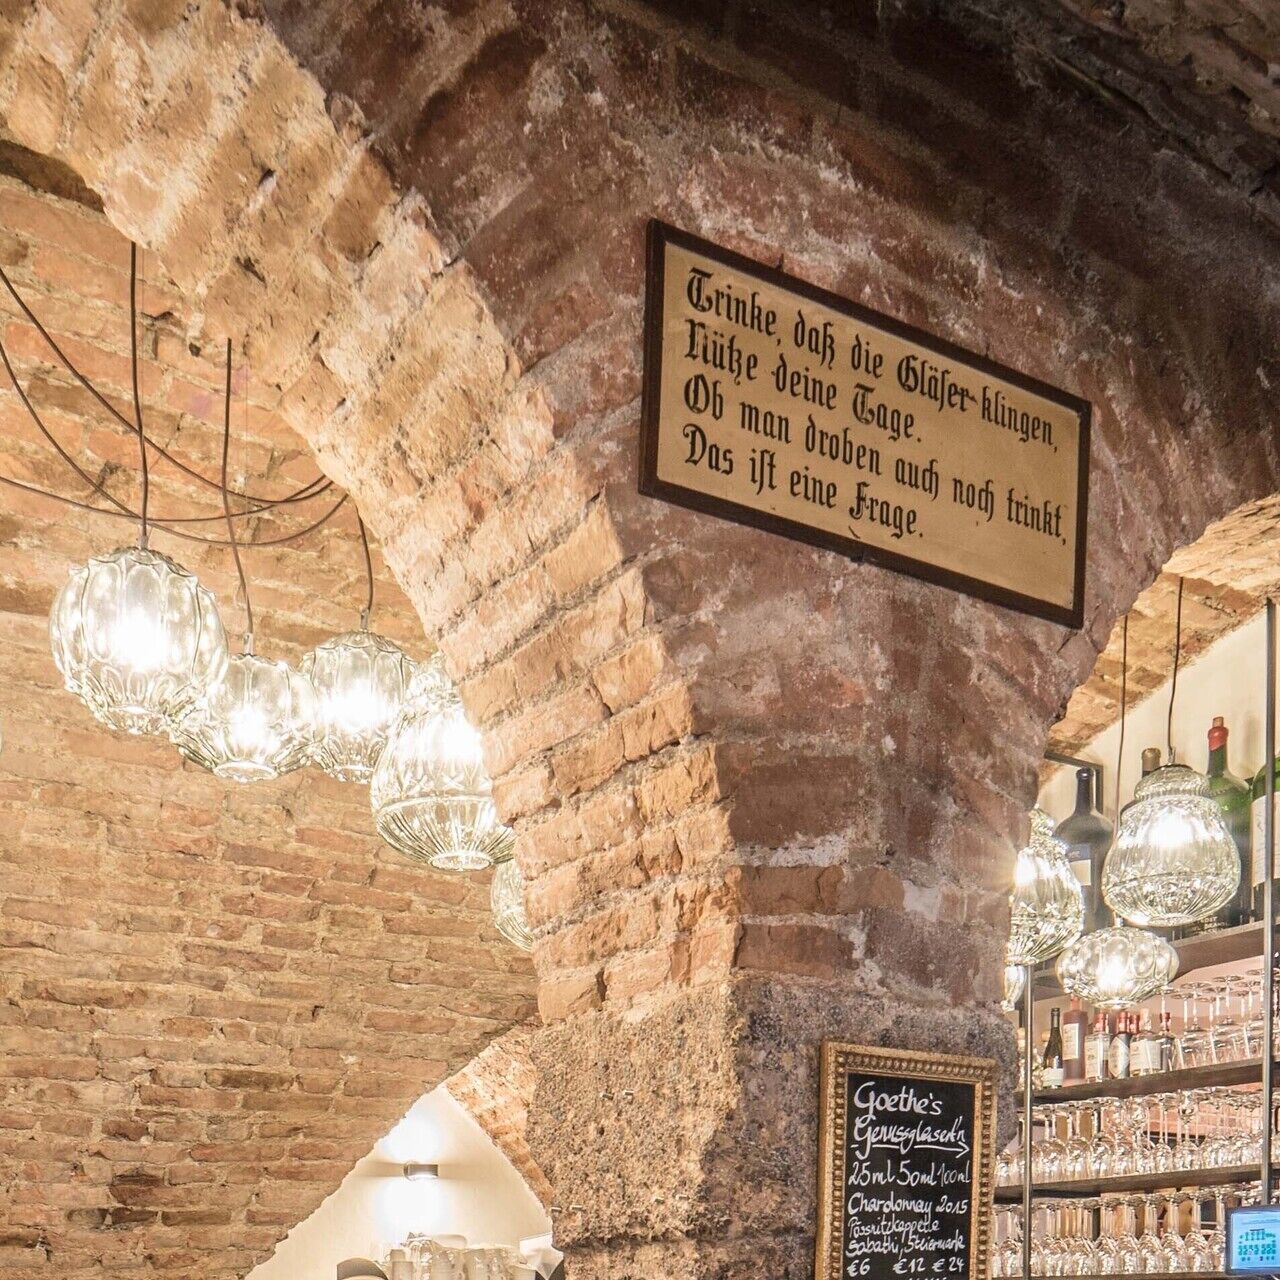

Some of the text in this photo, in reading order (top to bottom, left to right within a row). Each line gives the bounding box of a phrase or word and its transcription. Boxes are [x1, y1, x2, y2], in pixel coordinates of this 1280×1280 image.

[685, 319, 921, 443] Nütze deine Tage.
[687, 267, 781, 346] Trinke,
[794, 310, 835, 370] daß
[851, 334, 883, 379] die
[982, 386, 1058, 453] klingen,
[683, 423, 733, 475] Das
[790, 466, 837, 509] eine
[849, 481, 923, 540] Frage.
[684, 374, 1066, 545] Ob man droben auch noch trinkt,
[853, 1081, 943, 1119] Goethe's
[848, 1191, 969, 1218] Chardonnay 2015
